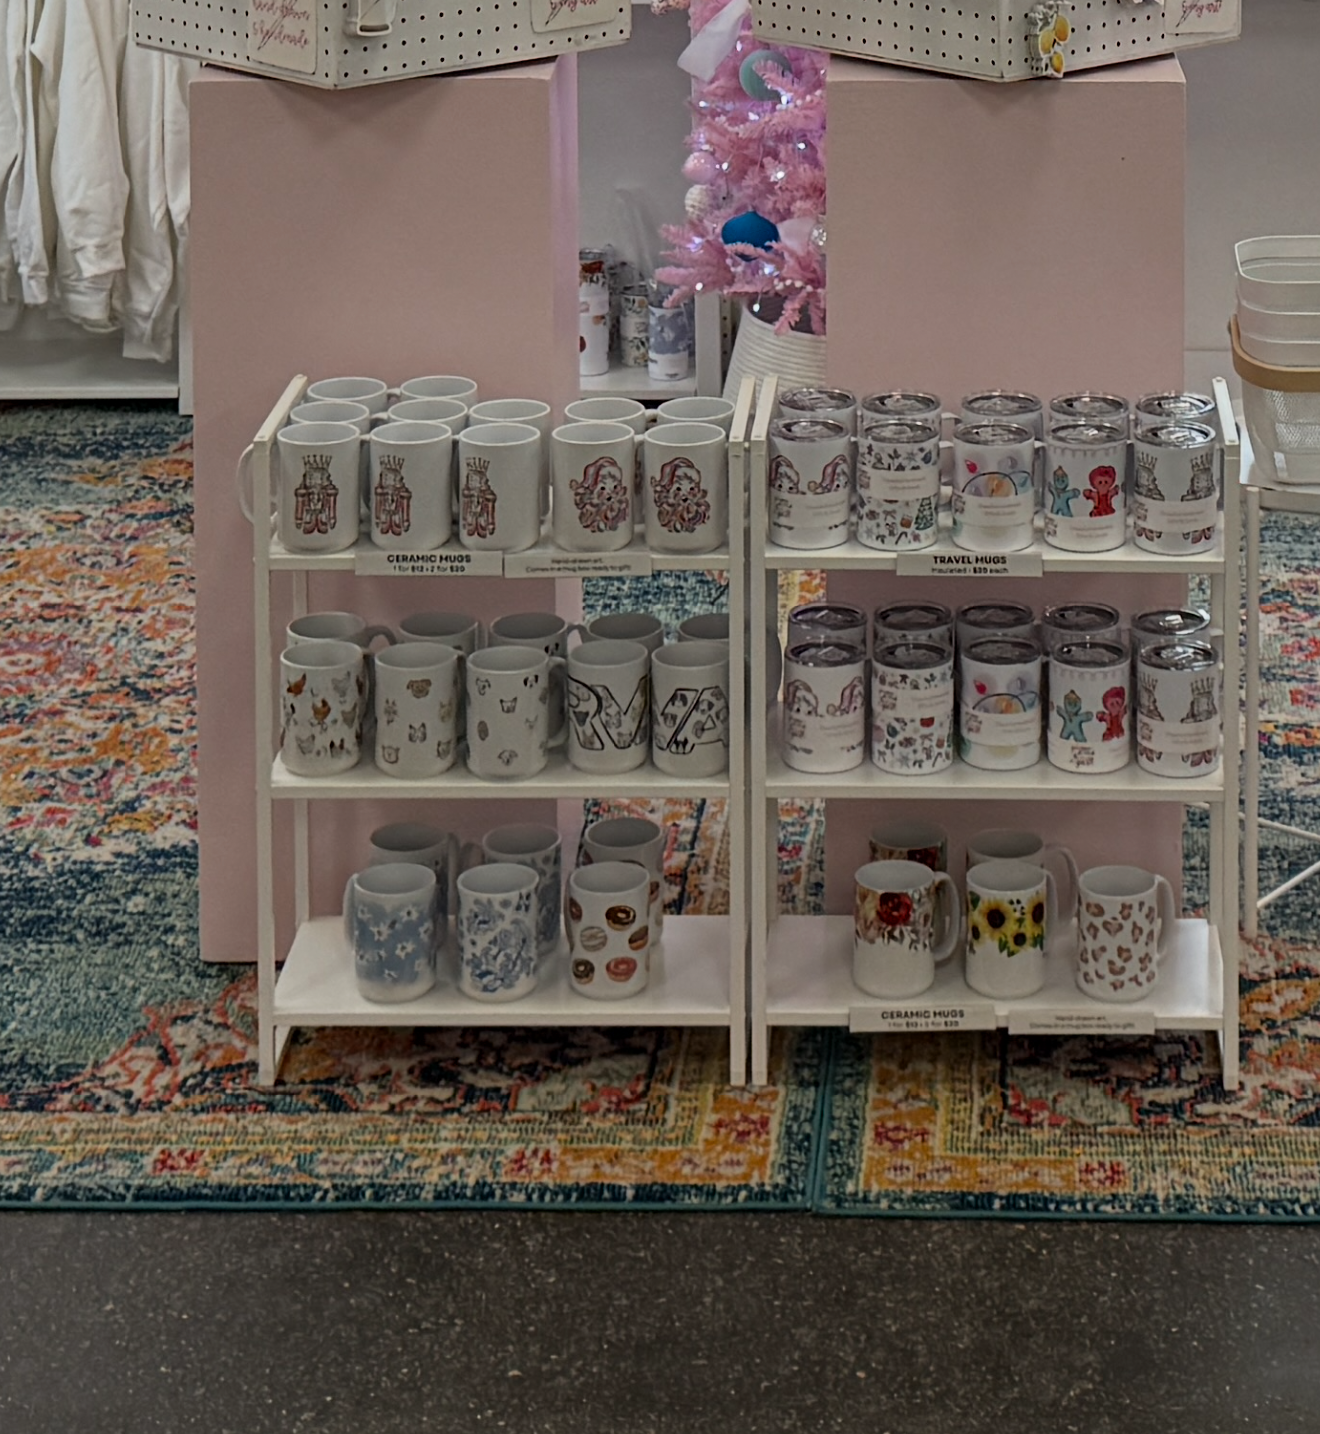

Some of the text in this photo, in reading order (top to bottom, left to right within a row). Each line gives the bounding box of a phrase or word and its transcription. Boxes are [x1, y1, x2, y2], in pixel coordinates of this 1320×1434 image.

[387, 554, 471, 563] CERAMIC MUGS
[933, 555, 1007, 564] TRAVEL MUGS
[881, 1009, 965, 1020] CERAMIC MUGS
